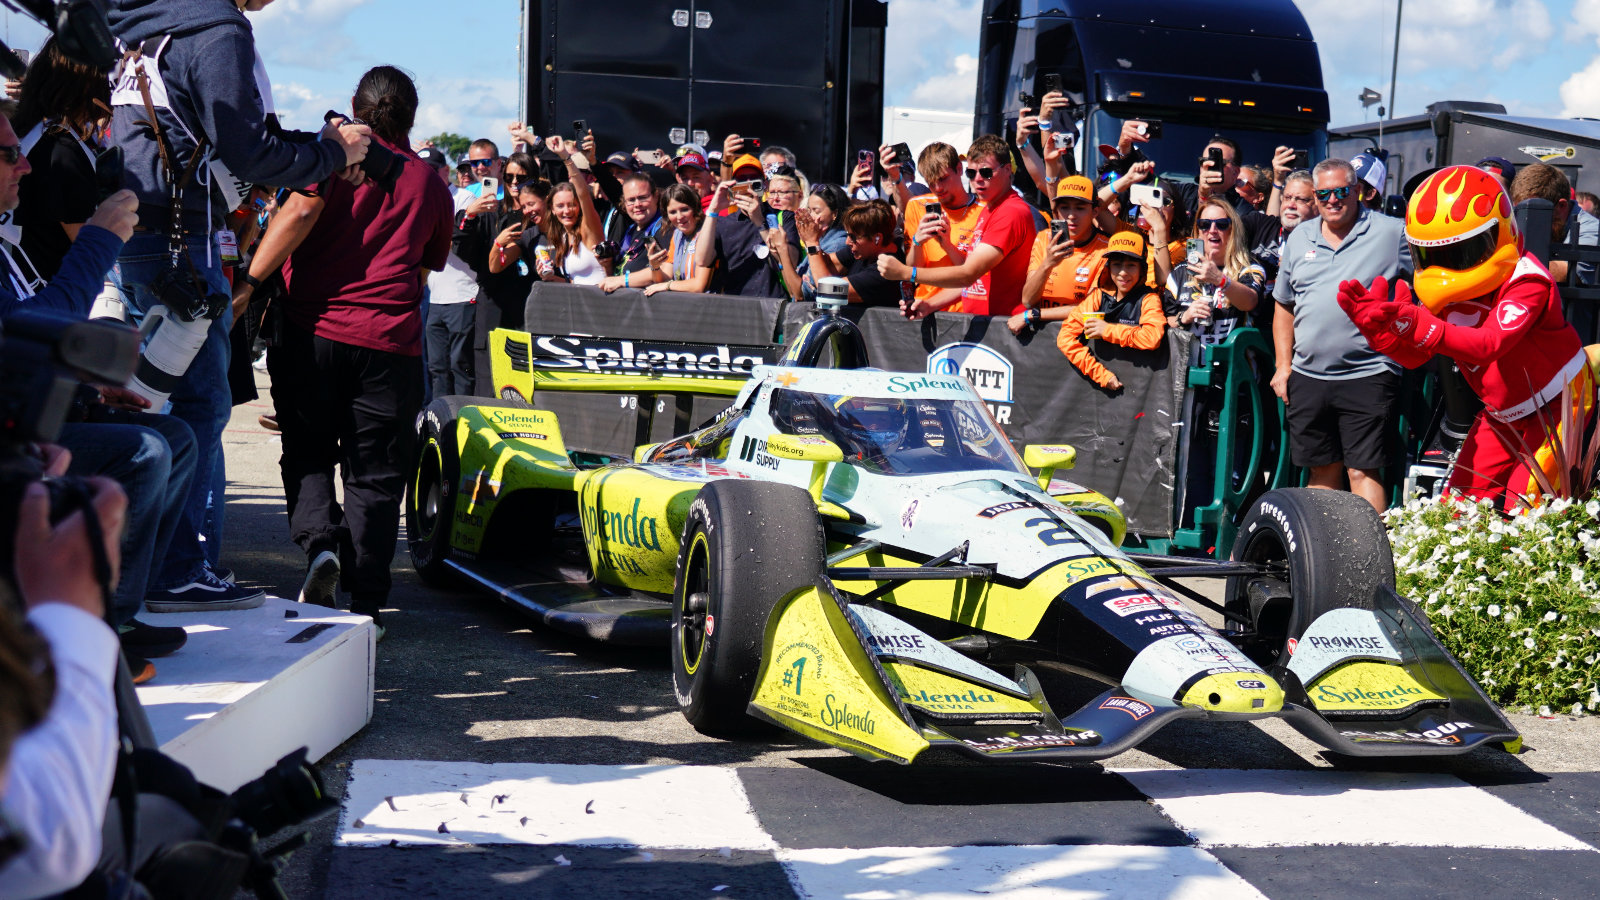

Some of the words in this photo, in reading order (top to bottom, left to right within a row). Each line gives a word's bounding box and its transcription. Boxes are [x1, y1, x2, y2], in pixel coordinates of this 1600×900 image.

[533, 337, 764, 373] Splenda
[965, 368, 1004, 389] NTT
[490, 411, 544, 424] Splenda
[756, 454, 780, 471] SUPPLY
[581, 479, 664, 554] Splenda
[986, 502, 1024, 515] JAVA
[1261, 502, 1296, 552] Firestone
[1309, 636, 1384, 649] PROMISE
[776, 642, 820, 664] RECOMMENDED
[816, 655, 824, 679] BRAND
[782, 657, 807, 696] #1
[1318, 685, 1423, 703] Splenda
[1361, 698, 1409, 706] STEVIA
[777, 703, 788, 711] AND
[821, 694, 875, 735] Splenda
[1126, 702, 1149, 716] HOUSE
[1022, 729, 1098, 741] POUR
[1405, 721, 1474, 739] POUR
